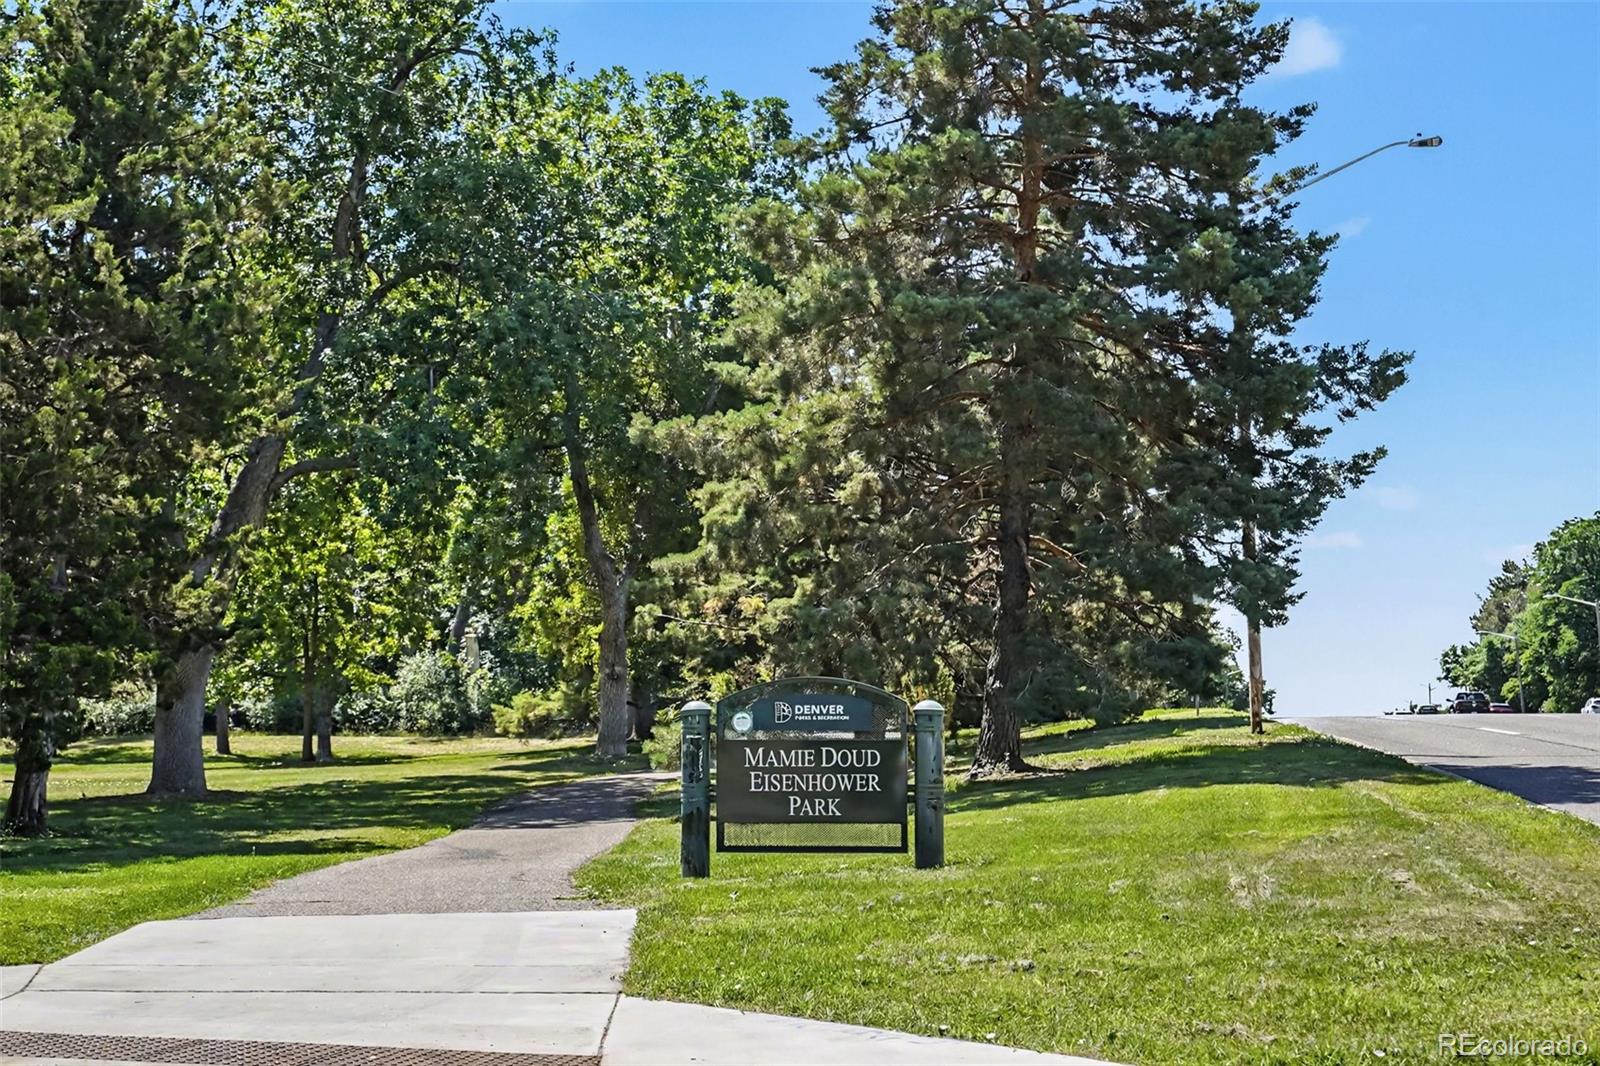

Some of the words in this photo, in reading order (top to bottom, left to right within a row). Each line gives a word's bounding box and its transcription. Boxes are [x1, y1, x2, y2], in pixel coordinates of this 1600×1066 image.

[795, 705, 844, 714] DENVER
[744, 747, 816, 767] MAMIE
[820, 747, 881, 767] DOUD
[749, 771, 882, 792] EISENHOWER
[788, 796, 842, 816] PARK
